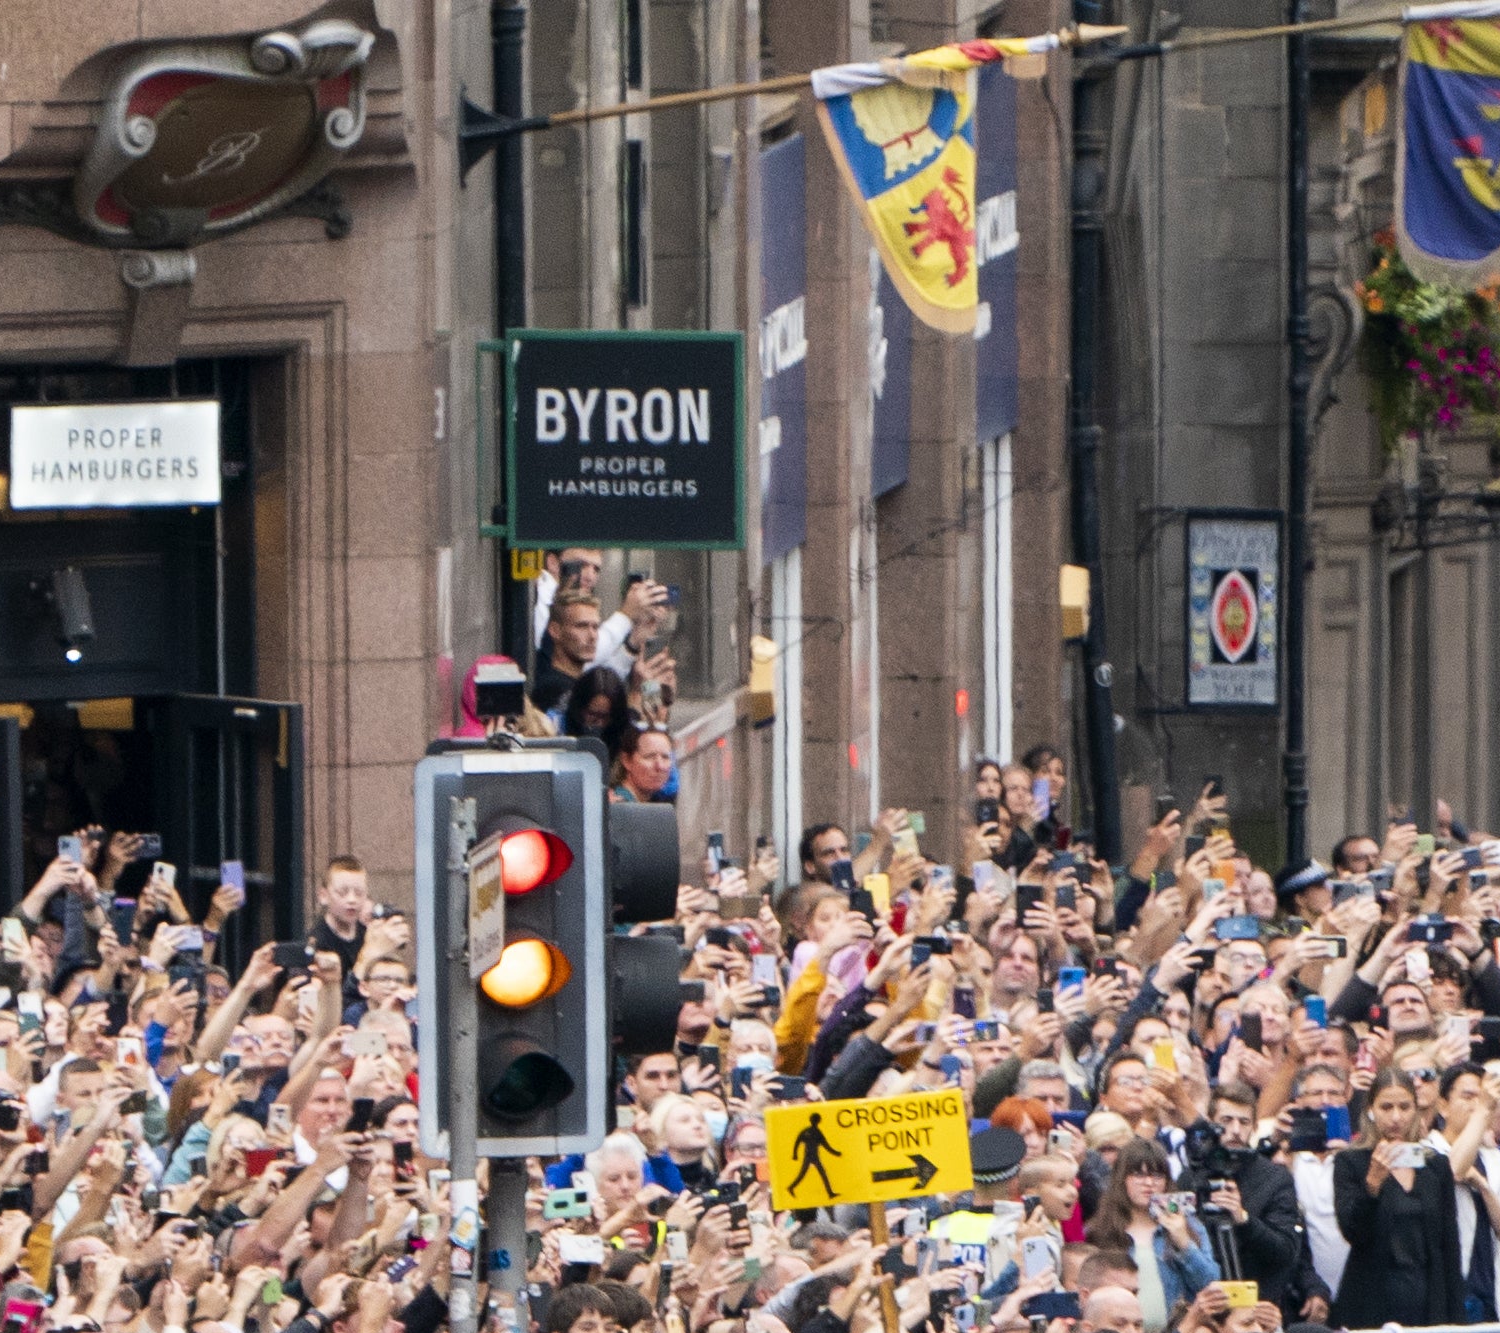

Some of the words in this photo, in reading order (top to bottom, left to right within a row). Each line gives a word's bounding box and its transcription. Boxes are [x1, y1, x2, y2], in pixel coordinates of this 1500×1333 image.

[535, 388, 711, 444] BYRON
[67, 427, 164, 451] PROPER
[31, 456, 201, 482] HAMBURGERS
[579, 457, 667, 476] PROPER
[548, 478, 700, 498] HAMBURGERS
[836, 1096, 960, 1129] CROSSING
[867, 1127, 935, 1152] POINT
